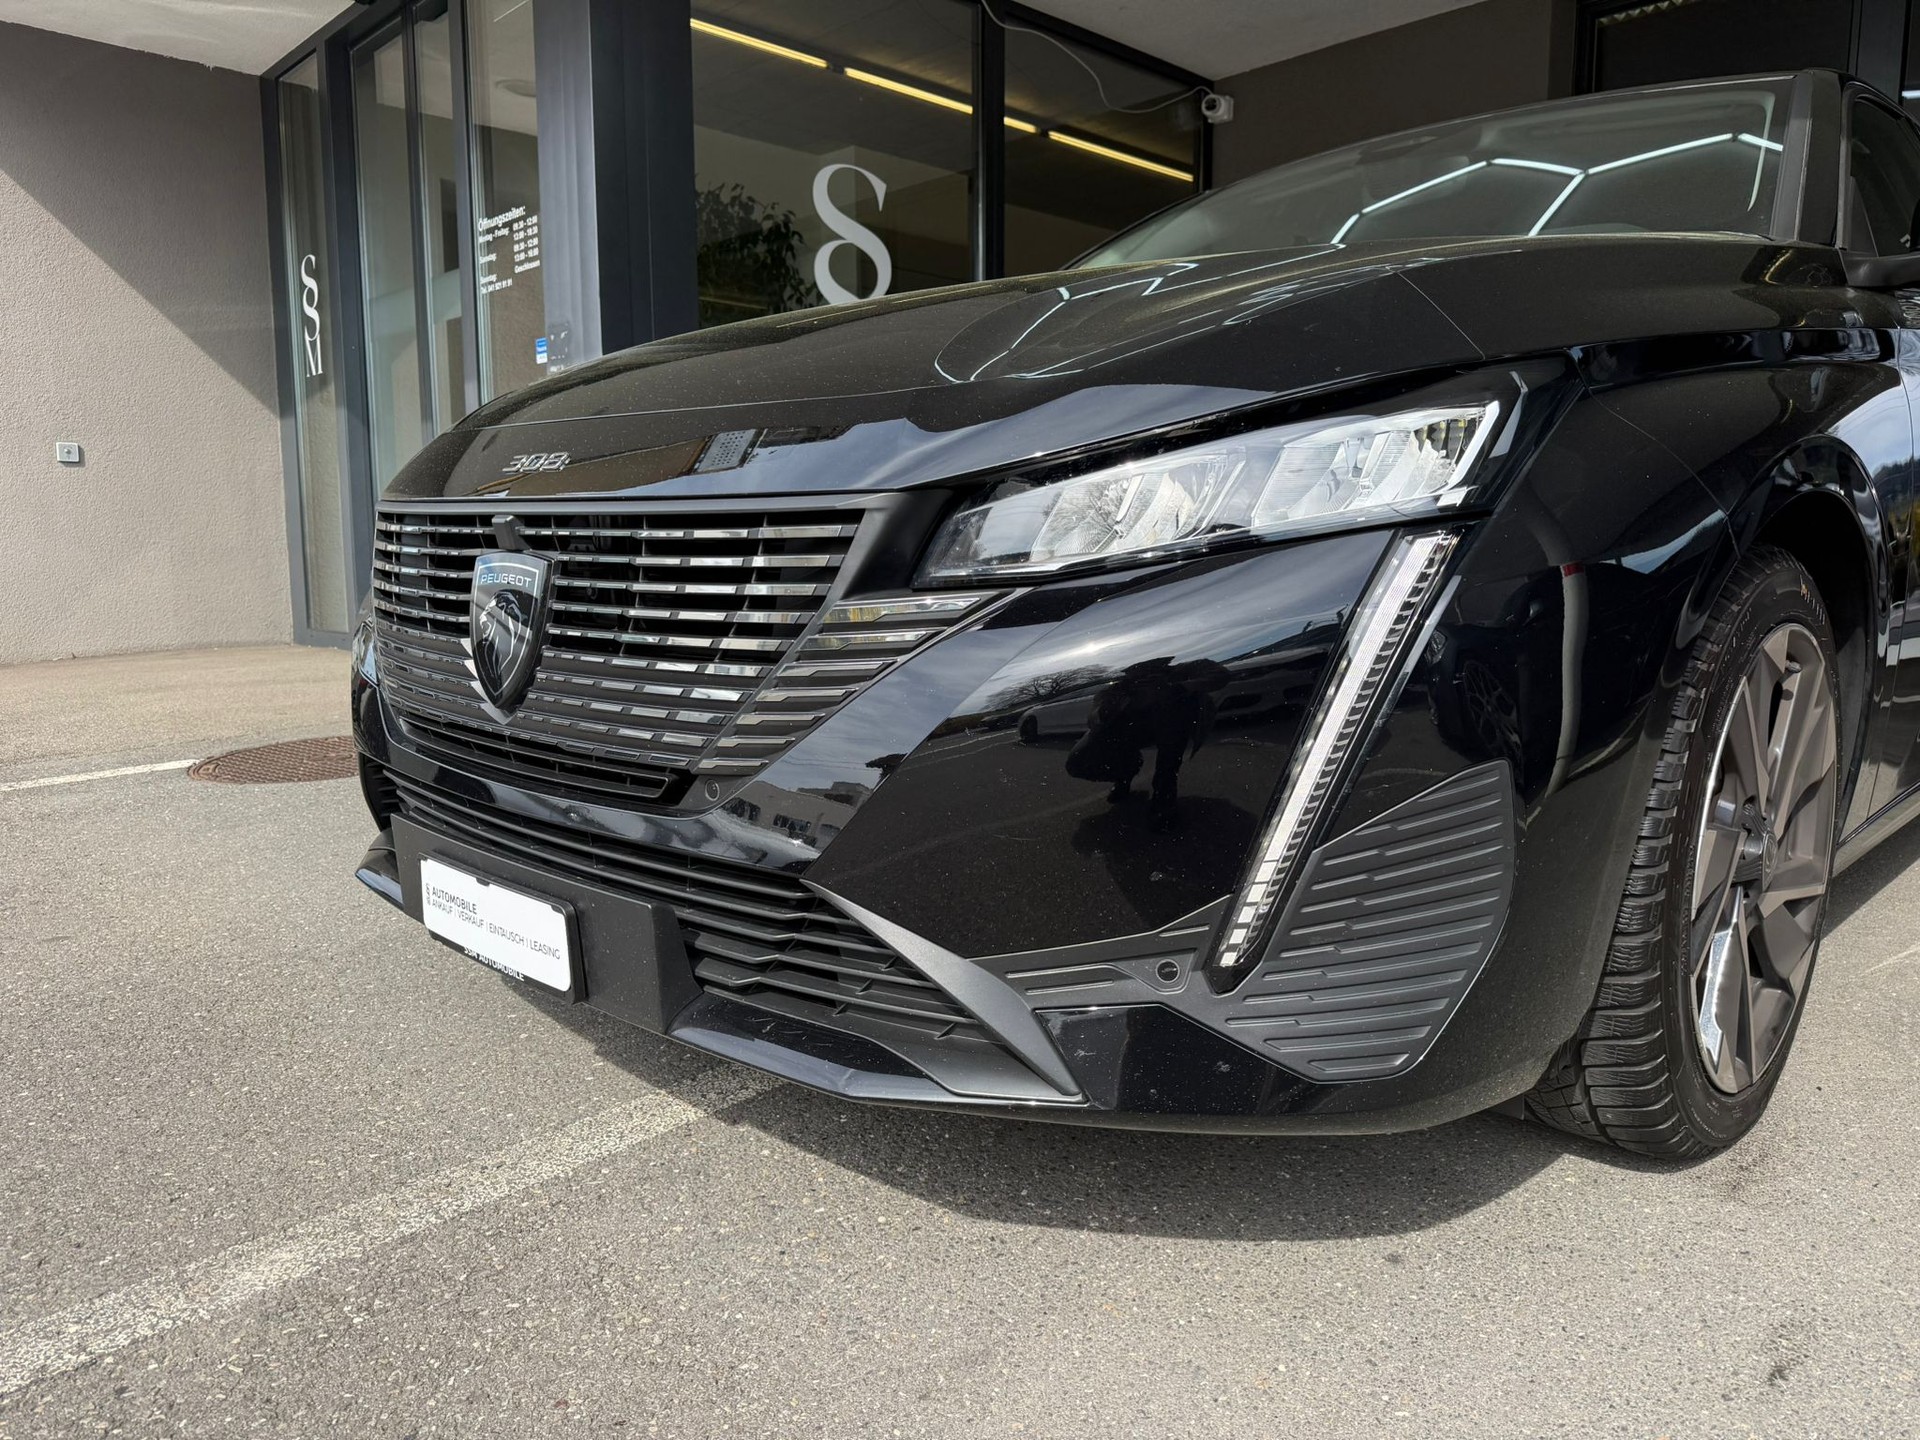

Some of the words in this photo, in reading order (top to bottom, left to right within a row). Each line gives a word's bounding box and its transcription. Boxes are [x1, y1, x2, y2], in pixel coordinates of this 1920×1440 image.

[478, 206, 526, 231] Öffnungszeiten:
[502, 452, 570, 473] 308
[481, 573, 532, 588] PEUGEOT
[432, 886, 477, 915] AUTOMOBILE
[432, 898, 453, 914] ANKAUF
[457, 909, 484, 928] VERKAUF
[489, 922, 524, 946] EINTAUSCH
[530, 940, 561, 960] LEASING
[478, 954, 525, 982] AUTOMOBILE
